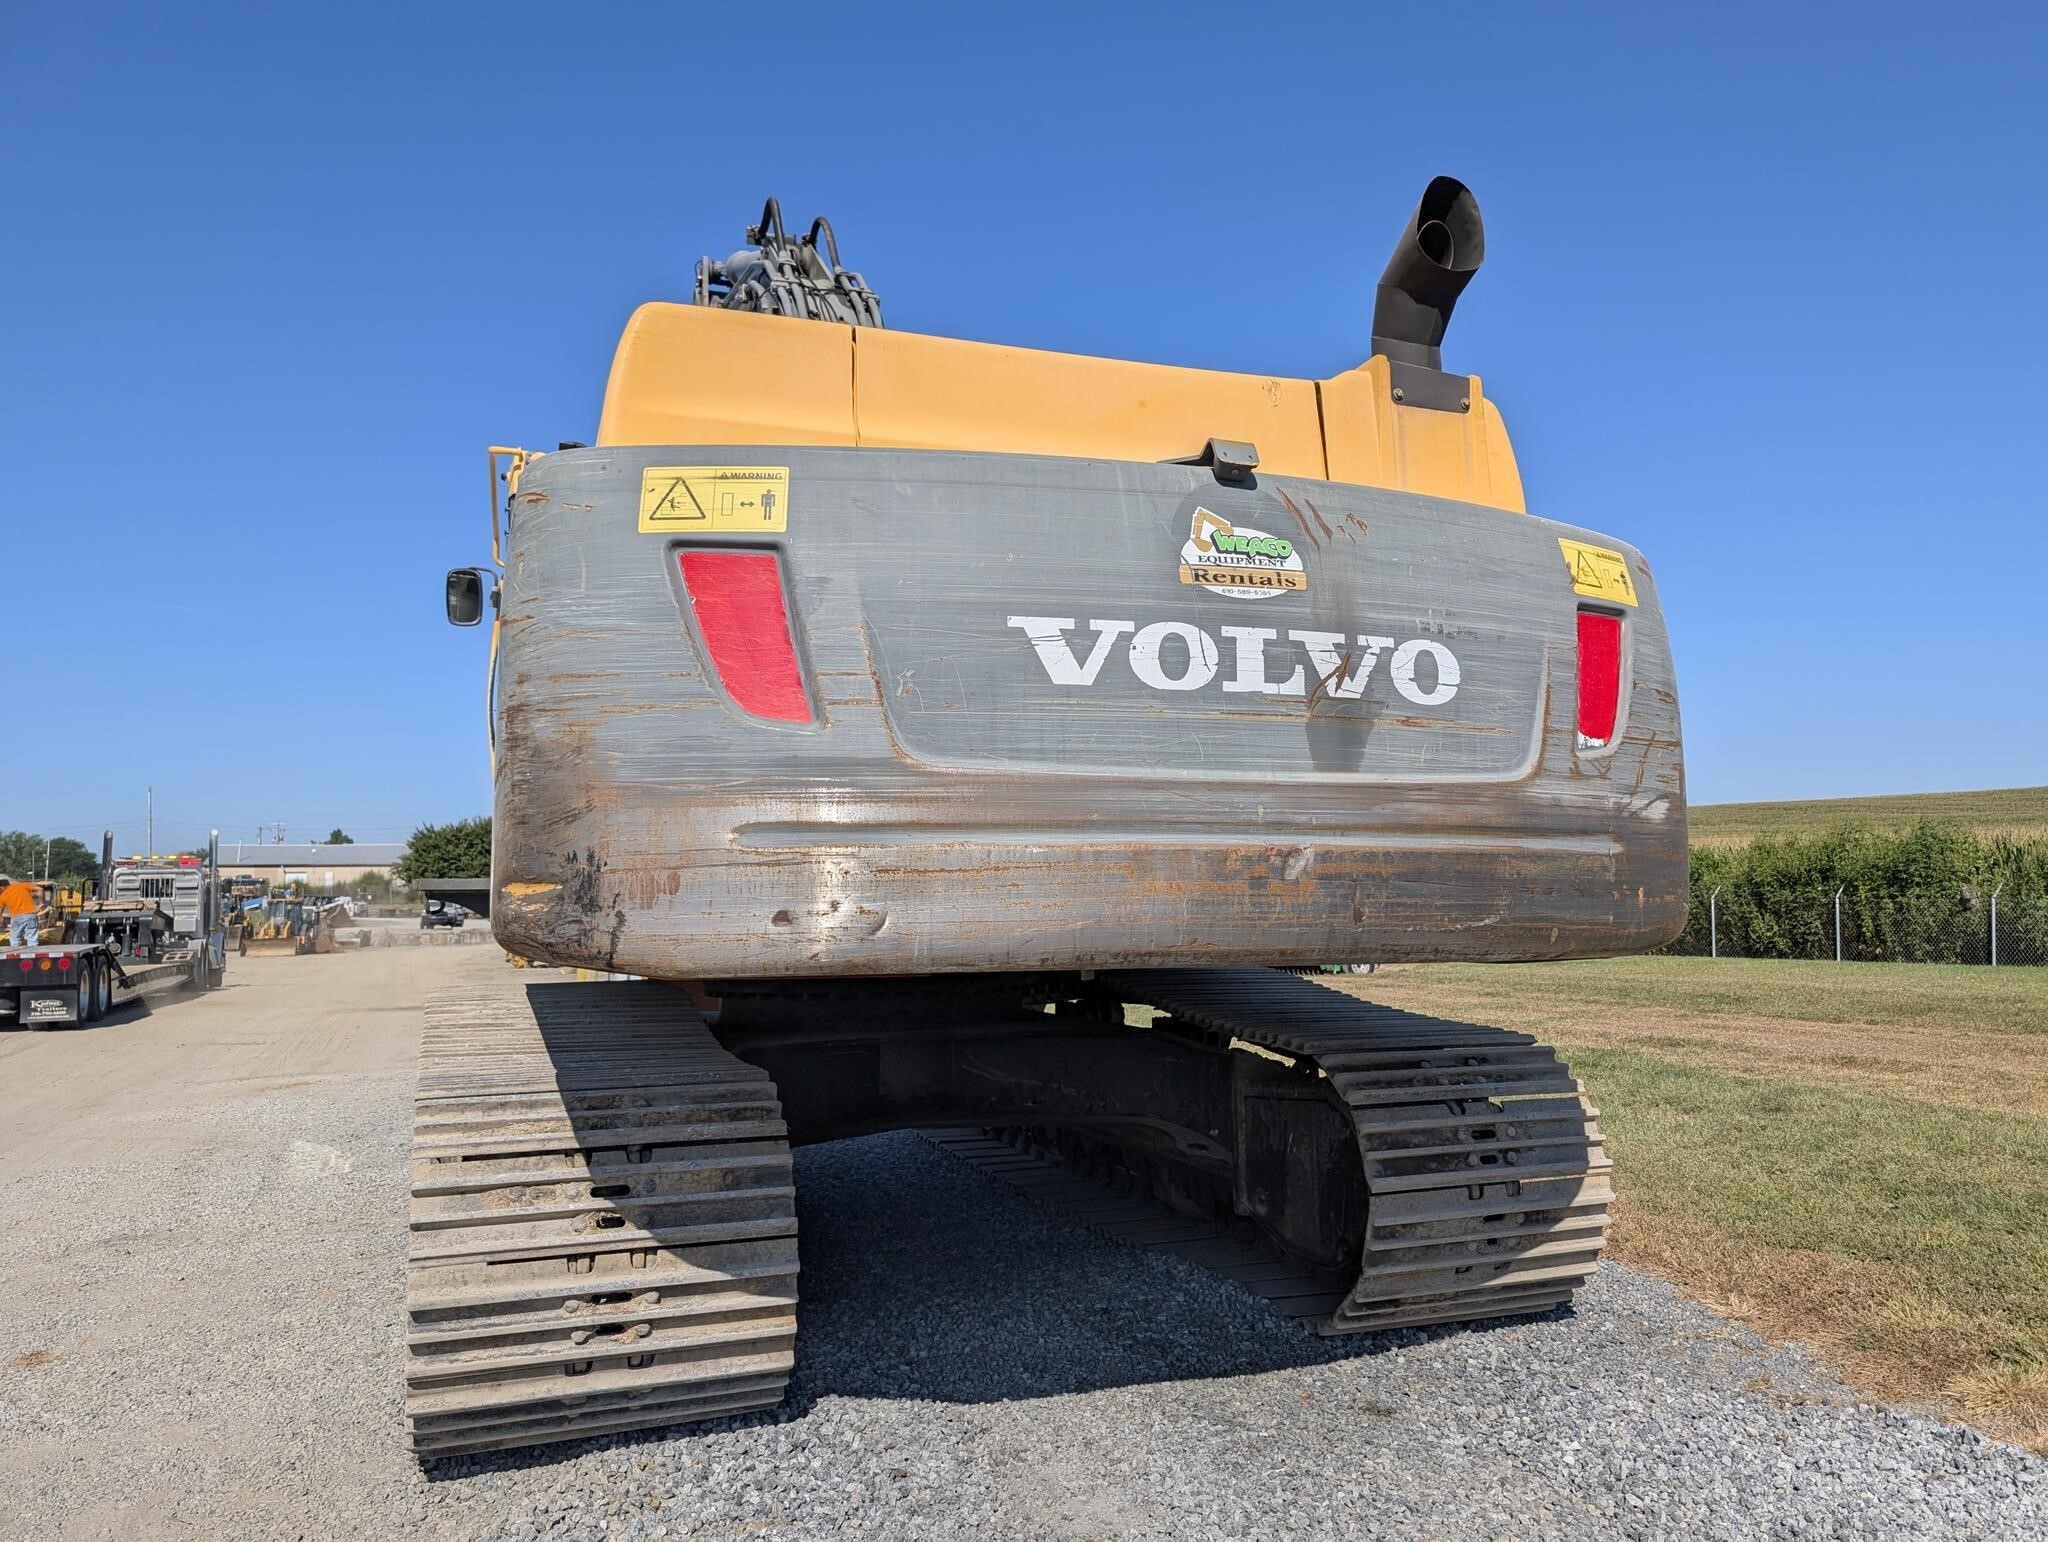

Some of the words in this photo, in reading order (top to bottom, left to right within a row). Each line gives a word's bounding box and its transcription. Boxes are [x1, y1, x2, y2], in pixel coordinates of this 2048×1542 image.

[731, 472, 783, 480] WARNING
[1210, 529, 1293, 560] WEACO
[1196, 555, 1287, 568] EQUIPMENT
[1191, 568, 1297, 588] Rentals
[1007, 615, 1461, 706] VOLVO
